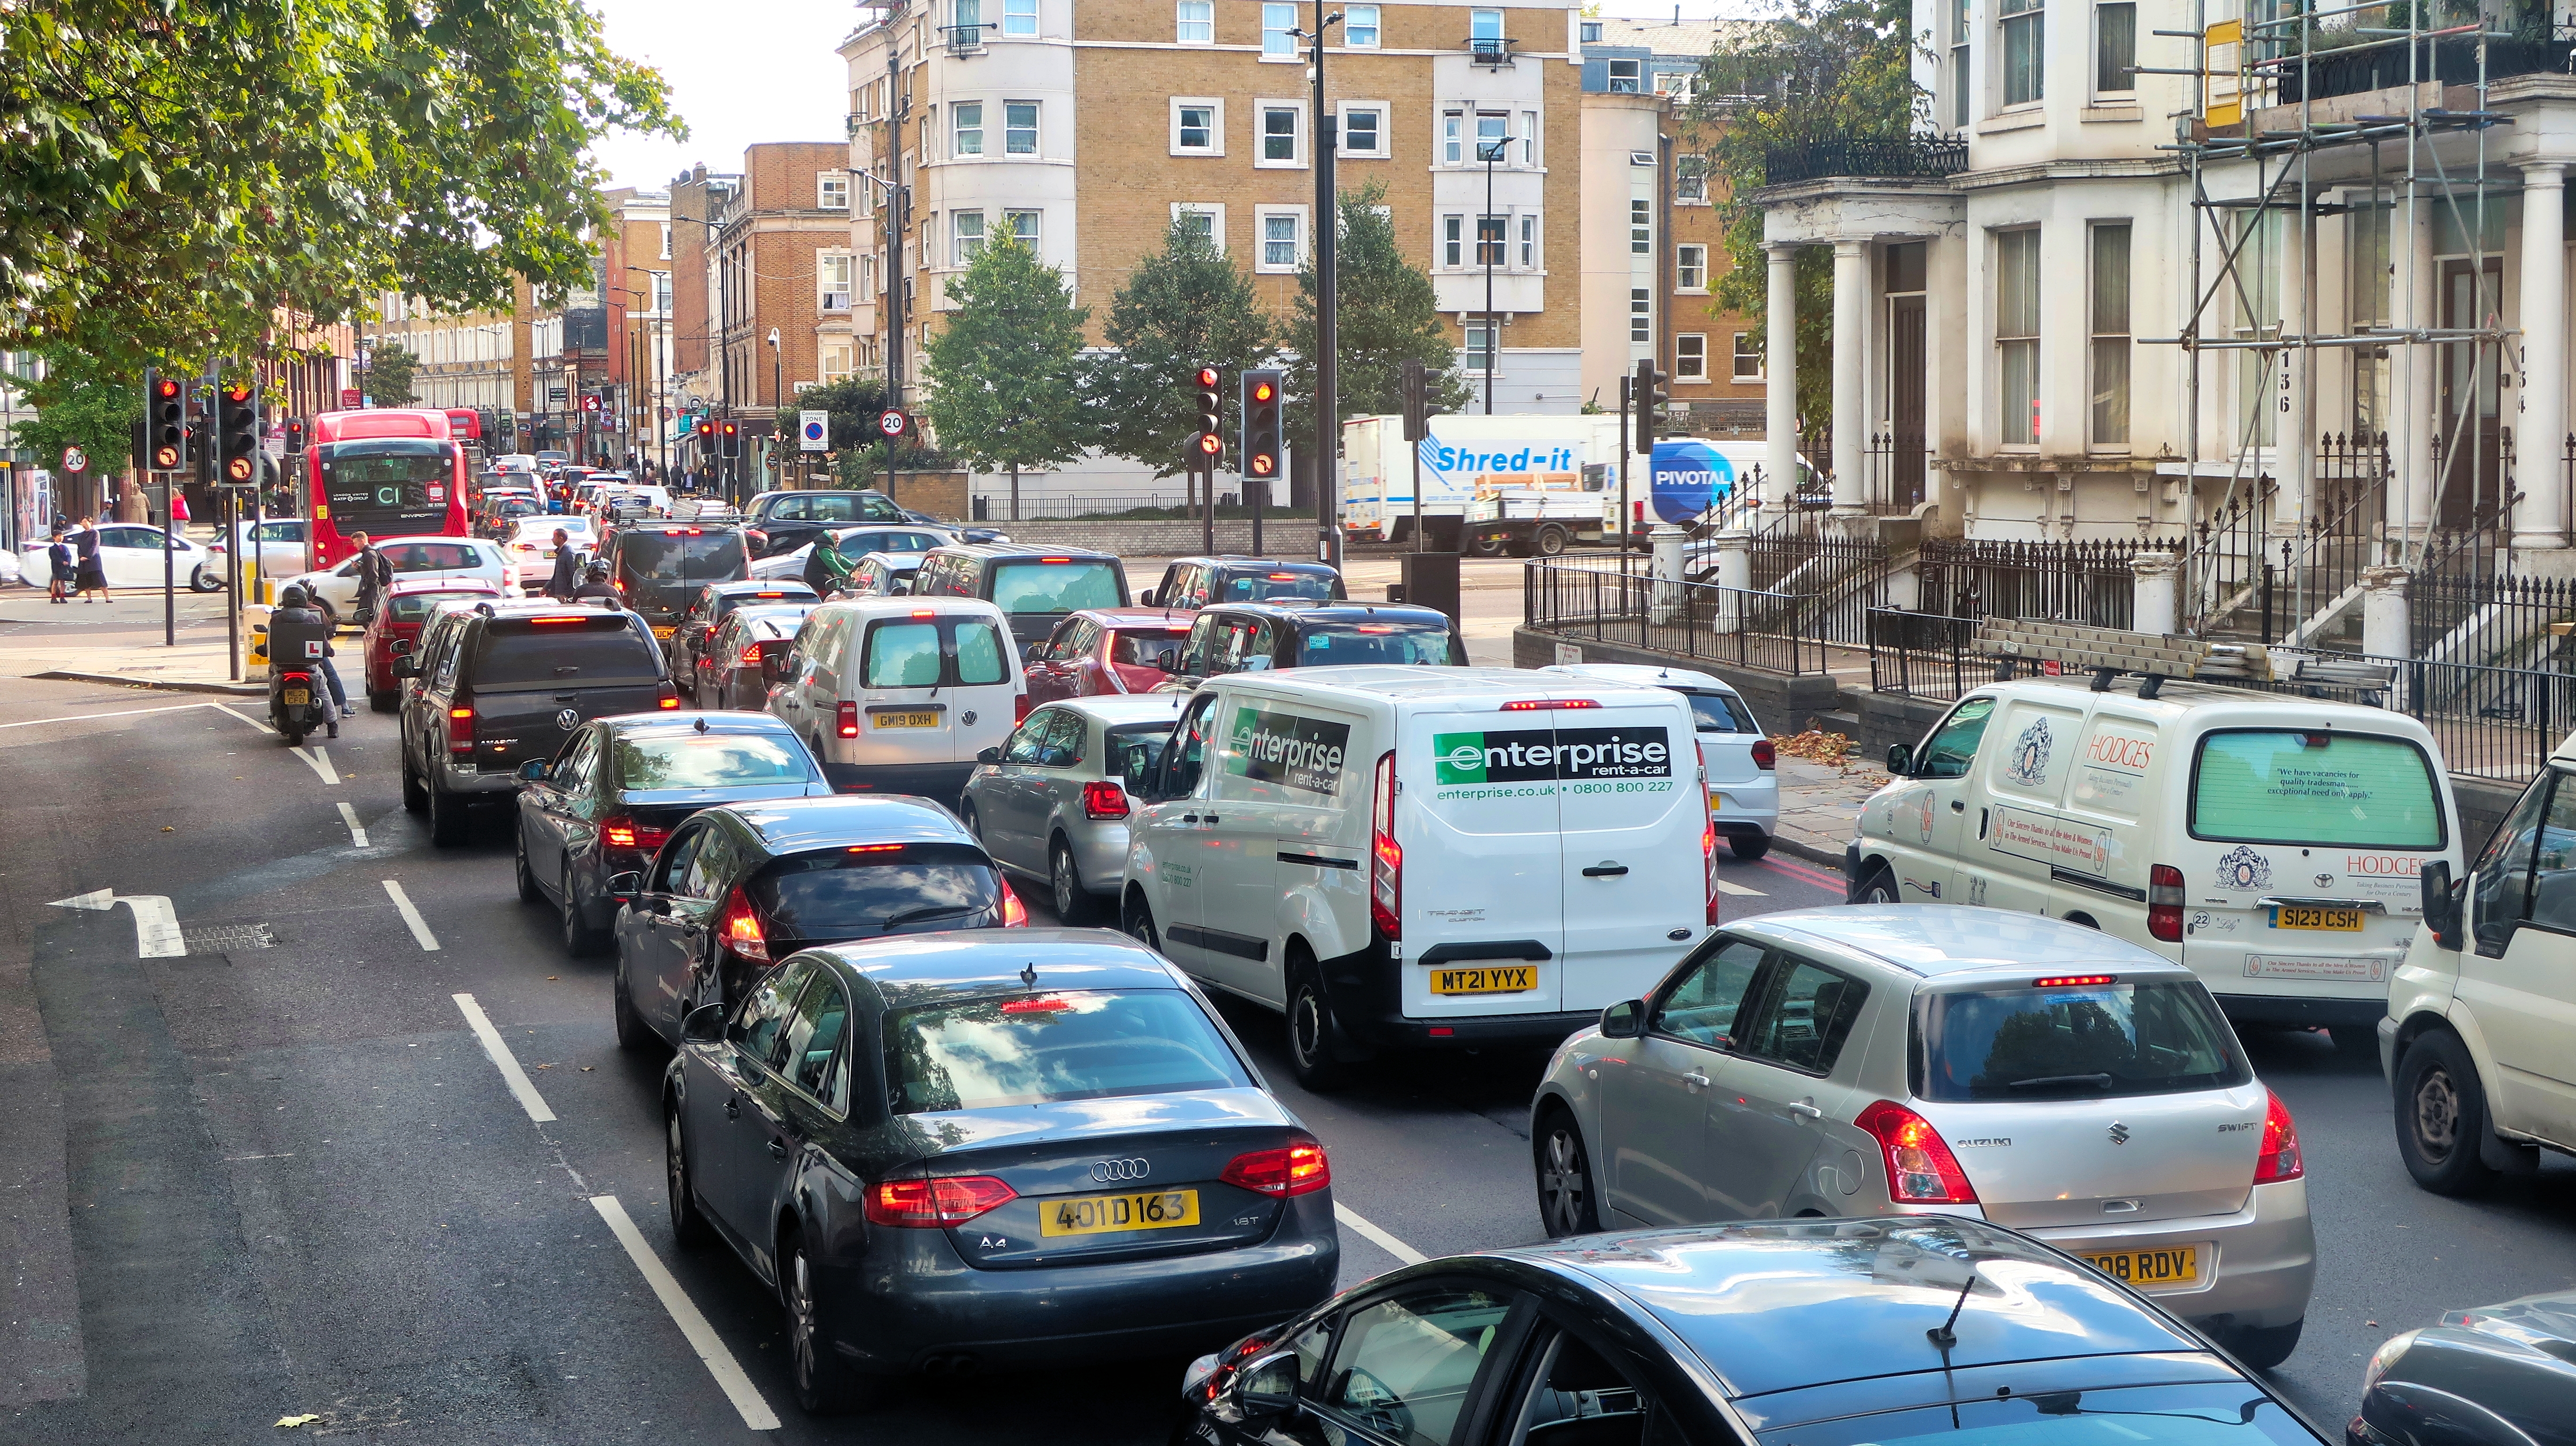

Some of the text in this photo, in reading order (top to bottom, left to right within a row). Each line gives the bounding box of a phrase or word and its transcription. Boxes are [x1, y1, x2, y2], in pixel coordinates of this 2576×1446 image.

[884, 418, 901, 428] 20
[67, 454, 84, 465] 20
[1435, 446, 1573, 471] Shred-it
[1656, 471, 1731, 485] PIVOTAL
[378, 487, 399, 504] C1
[309, 643, 319, 653] L
[2045, 666, 2059, 675] Tipping
[880, 714, 932, 726] GM19 OXH
[1231, 726, 1342, 776] enterprise
[1434, 735, 1667, 772] enterprise
[2086, 734, 2155, 769] HODGES
[1592, 763, 1667, 777] rent-a-car
[2294, 768, 2311, 776] have
[1294, 771, 1338, 792] rent-a-car
[1573, 781, 1674, 794] 0800 800 227
[2280, 778, 2305, 787] quality
[1437, 785, 1556, 801] enterprise.co.uk
[2267, 787, 2310, 796] exceptional
[2331, 790, 2346, 798] only
[2007, 819, 2015, 827] Our
[2016, 820, 2030, 832] Sincere
[2030, 824, 2044, 835] Thanks
[2063, 832, 2072, 841] Men
[2077, 835, 2093, 846] Women
[2018, 834, 2030, 844] Armed
[2061, 844, 2072, 854] Make
[2073, 847, 2078, 856] Us
[2079, 848, 2093, 860] Proud
[1162, 872, 1191, 887] 0800 800 227
[2195, 916, 2208, 924] 22
[2284, 909, 2359, 928] S123 CSH
[1442, 968, 1527, 990] MT21 YYX
[2217, 1122, 2258, 1133] SWIFT
[1956, 1138, 2012, 1149] SUZUKI
[979, 1236, 1006, 1249] A4
[2138, 1251, 2185, 1279] RDV
